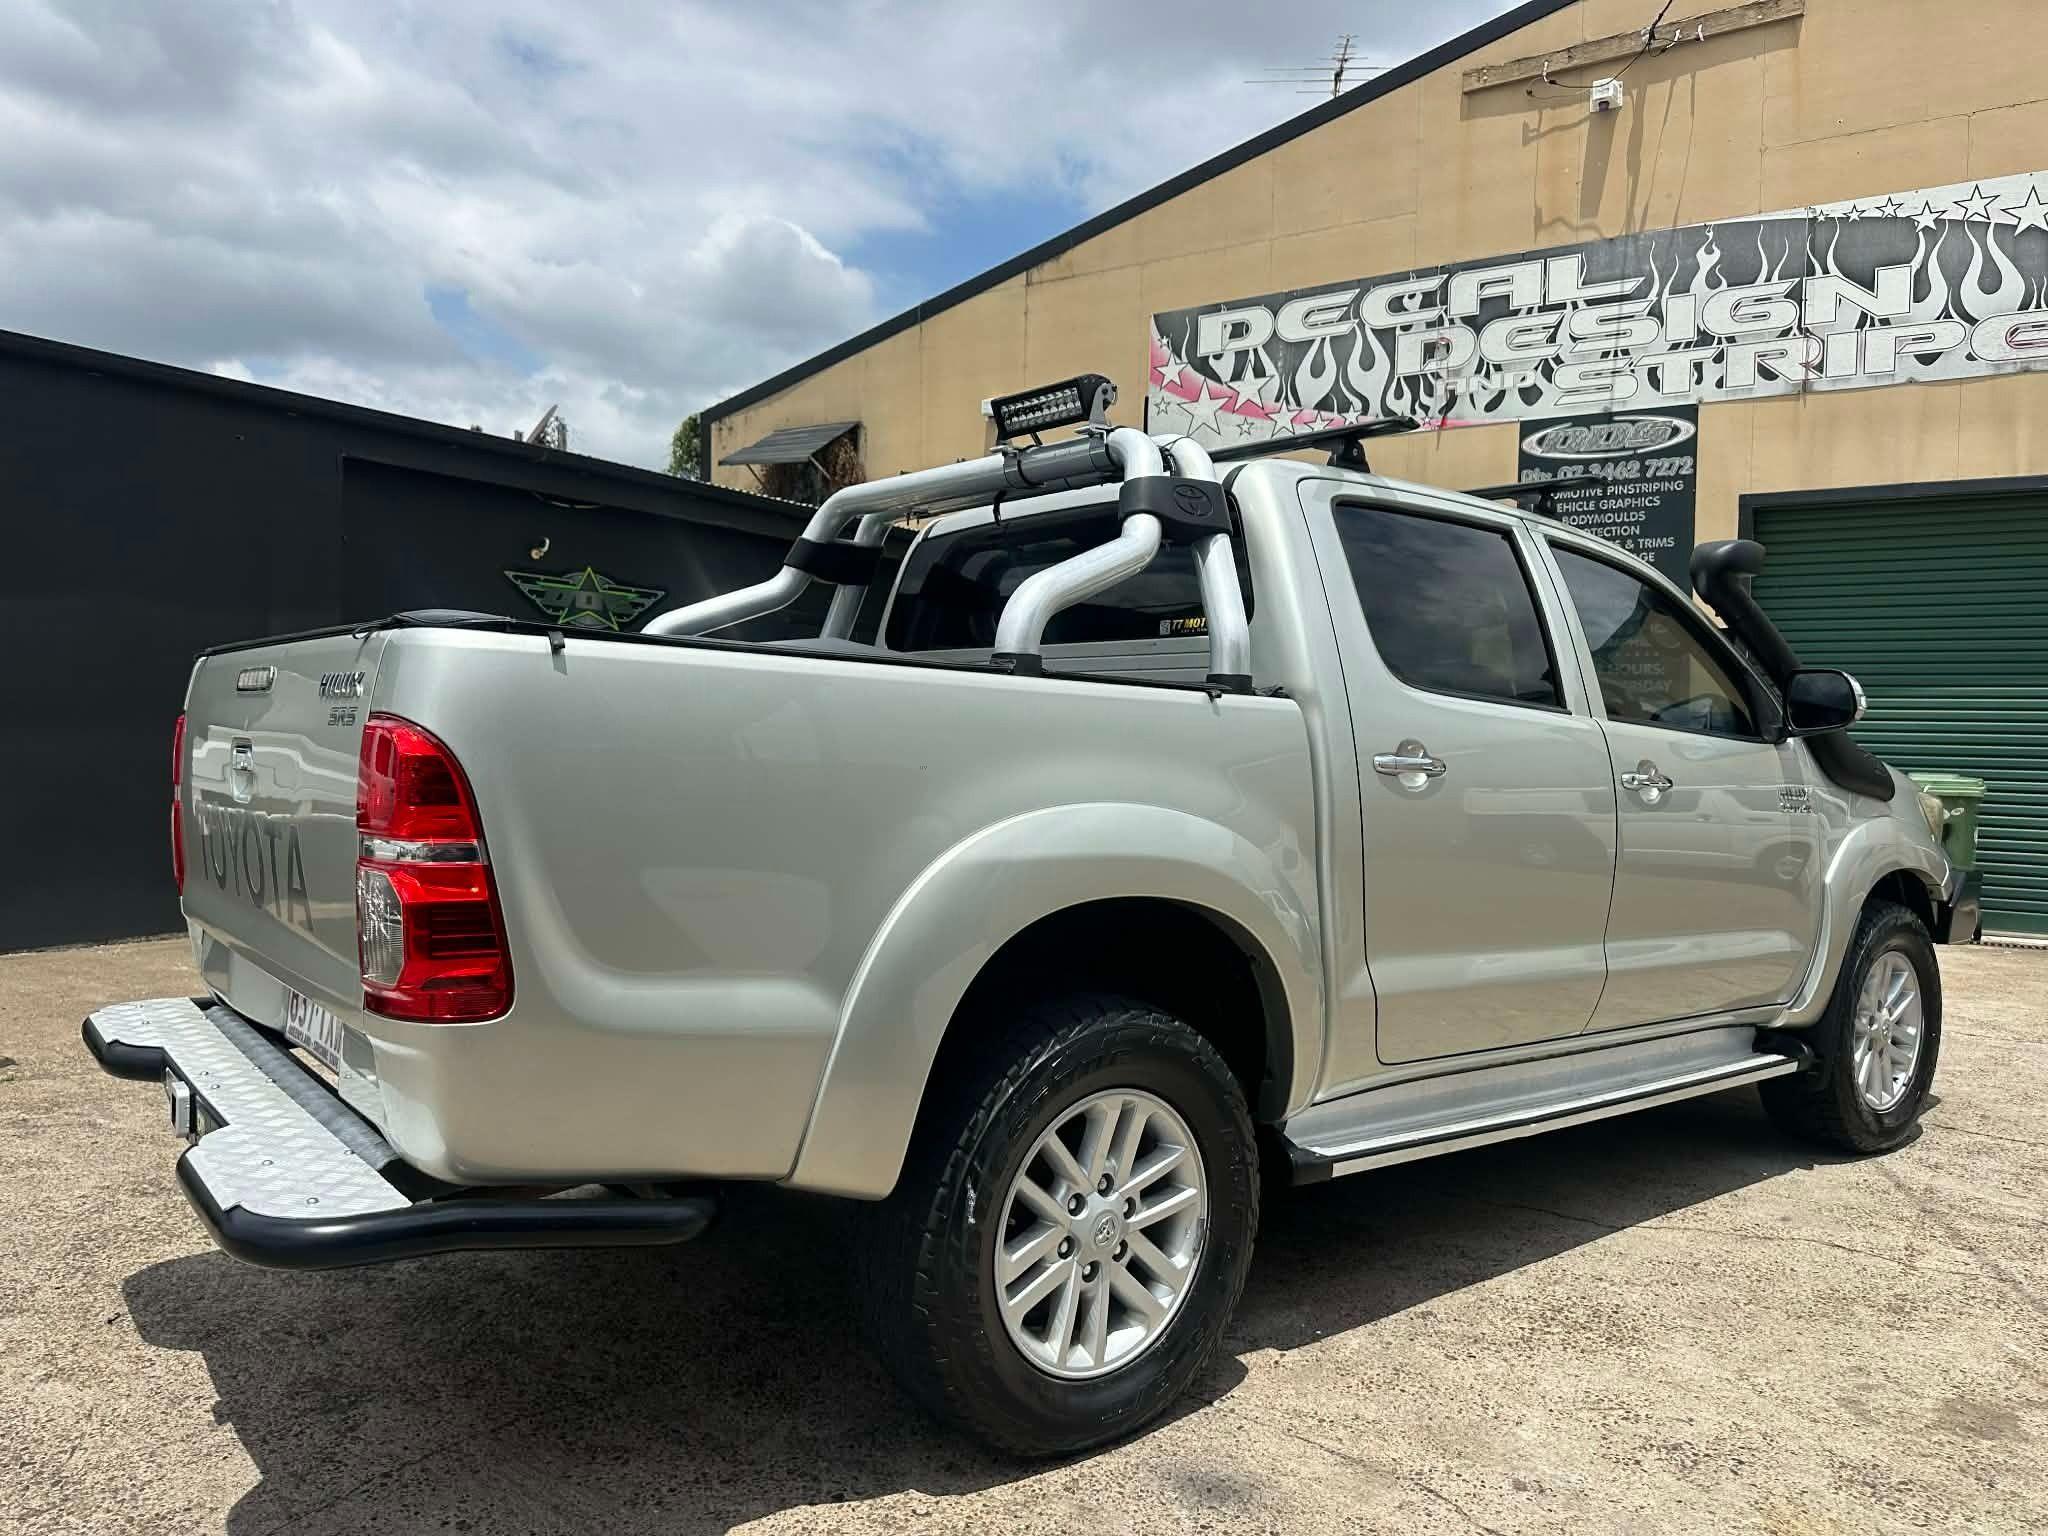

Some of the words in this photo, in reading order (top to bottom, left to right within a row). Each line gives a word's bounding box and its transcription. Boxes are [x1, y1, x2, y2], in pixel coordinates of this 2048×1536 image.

[1197, 253, 1646, 358] DECAL
[1396, 263, 1914, 377] DESIGN
[1437, 371, 1540, 397] AND
[1645, 455, 1695, 479] 7272
[1607, 480, 1685, 496] PINSTRIPING
[1556, 500, 1596, 513] EHICLE
[1599, 496, 1661, 510] GRAPHICS
[1562, 511, 1646, 526] BODYMOULDS
[1624, 538, 1634, 550] &
[1638, 537, 1675, 549] TRIMS
[319, 671, 366, 698] HILUX
[198, 808, 314, 932] TOYOTA
